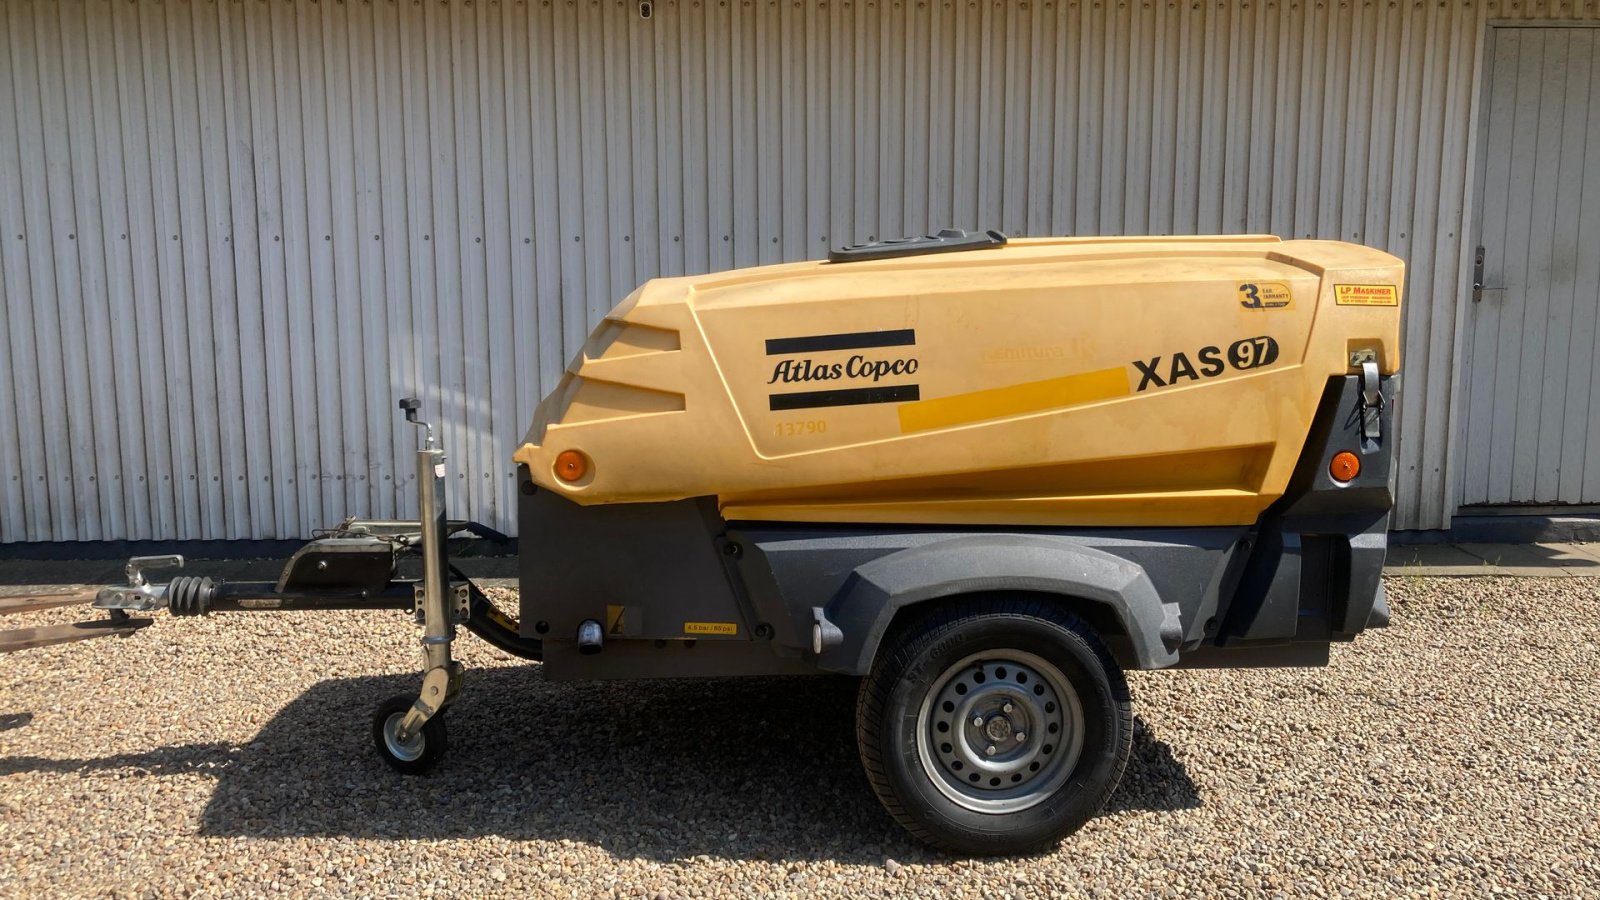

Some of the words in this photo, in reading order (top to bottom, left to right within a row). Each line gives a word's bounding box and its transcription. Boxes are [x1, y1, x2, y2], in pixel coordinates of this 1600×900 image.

[1239, 283, 1261, 308] 3
[1340, 287, 1351, 295] LP
[767, 359, 842, 385] Atlas
[846, 355, 919, 382] Copco
[1131, 345, 1225, 392] XAS
[1236, 337, 1270, 369] 97
[775, 420, 827, 438] 13790
